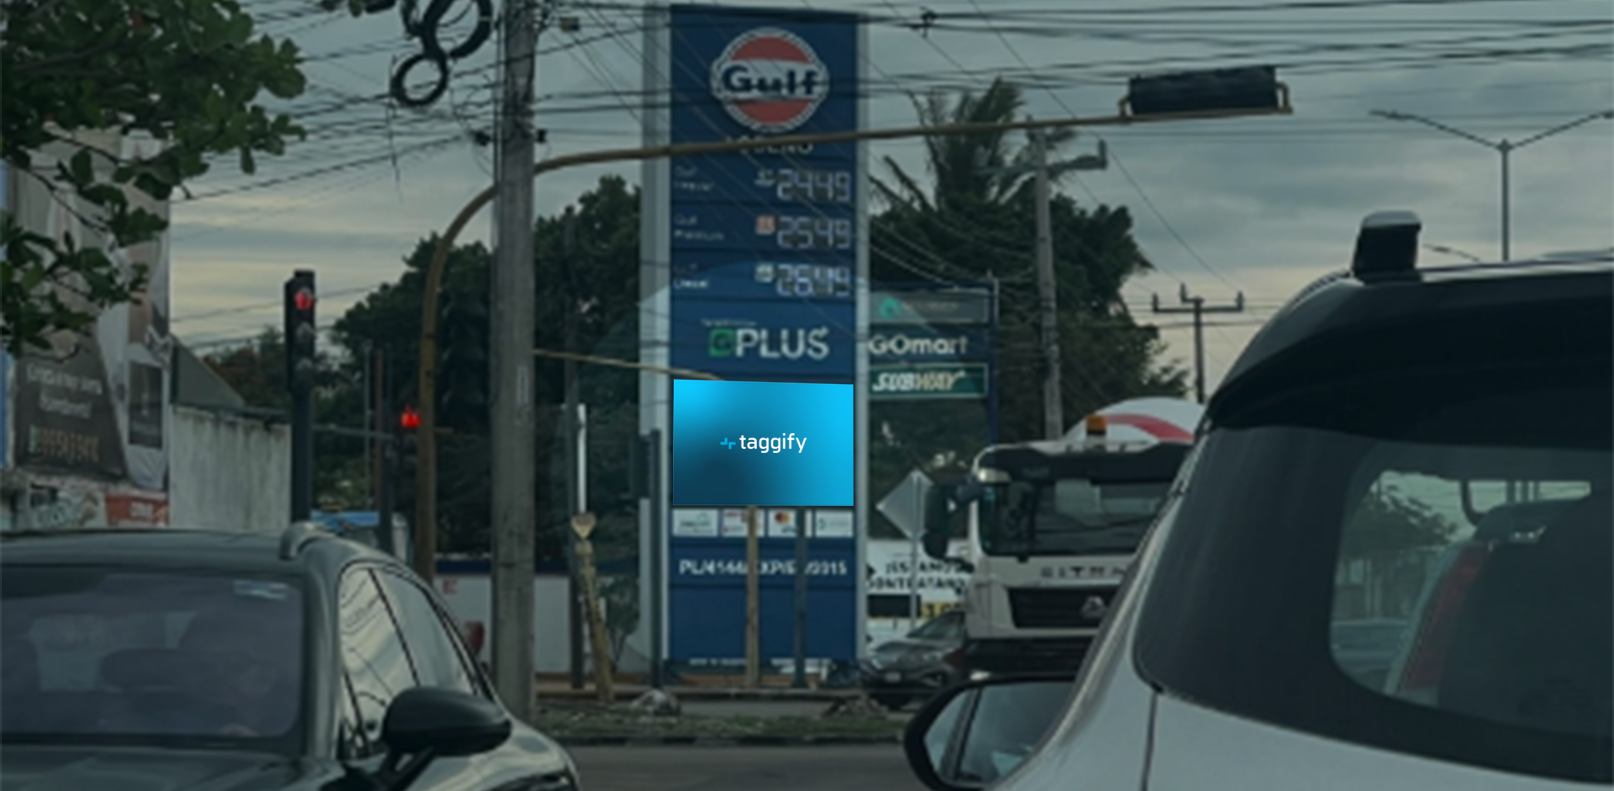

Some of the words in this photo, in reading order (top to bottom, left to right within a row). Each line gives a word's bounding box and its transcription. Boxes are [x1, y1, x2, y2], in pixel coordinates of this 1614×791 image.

[722, 64, 819, 96] Gulf
[872, 369, 965, 392] SUBWAY
[738, 432, 807, 454] taggify
